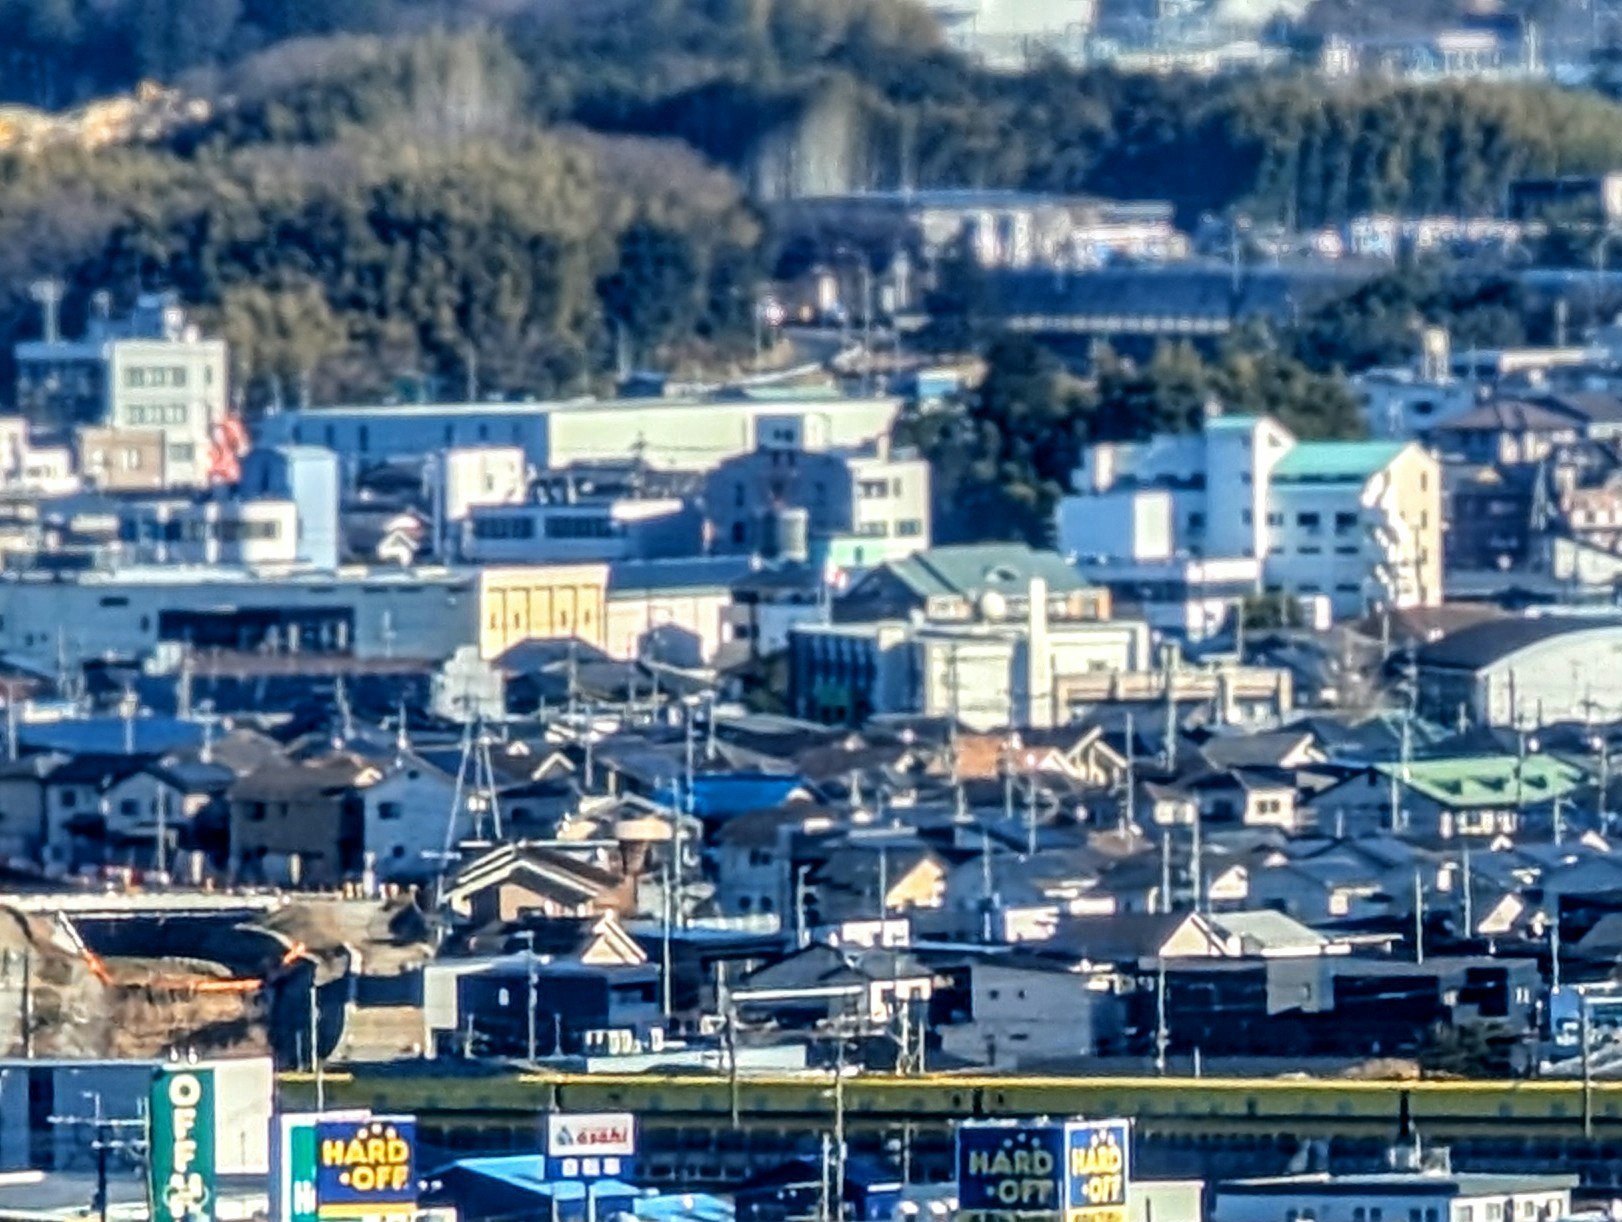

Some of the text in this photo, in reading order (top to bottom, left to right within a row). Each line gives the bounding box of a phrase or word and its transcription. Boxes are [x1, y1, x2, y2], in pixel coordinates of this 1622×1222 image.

[322, 1138, 409, 1166] HARD
[969, 1150, 1054, 1176] HARD
[1071, 1145, 1123, 1177] HARD
[352, 1165, 409, 1191] OFF
[998, 1178, 1054, 1203] OFF
[1088, 1174, 1123, 1203] OFF
